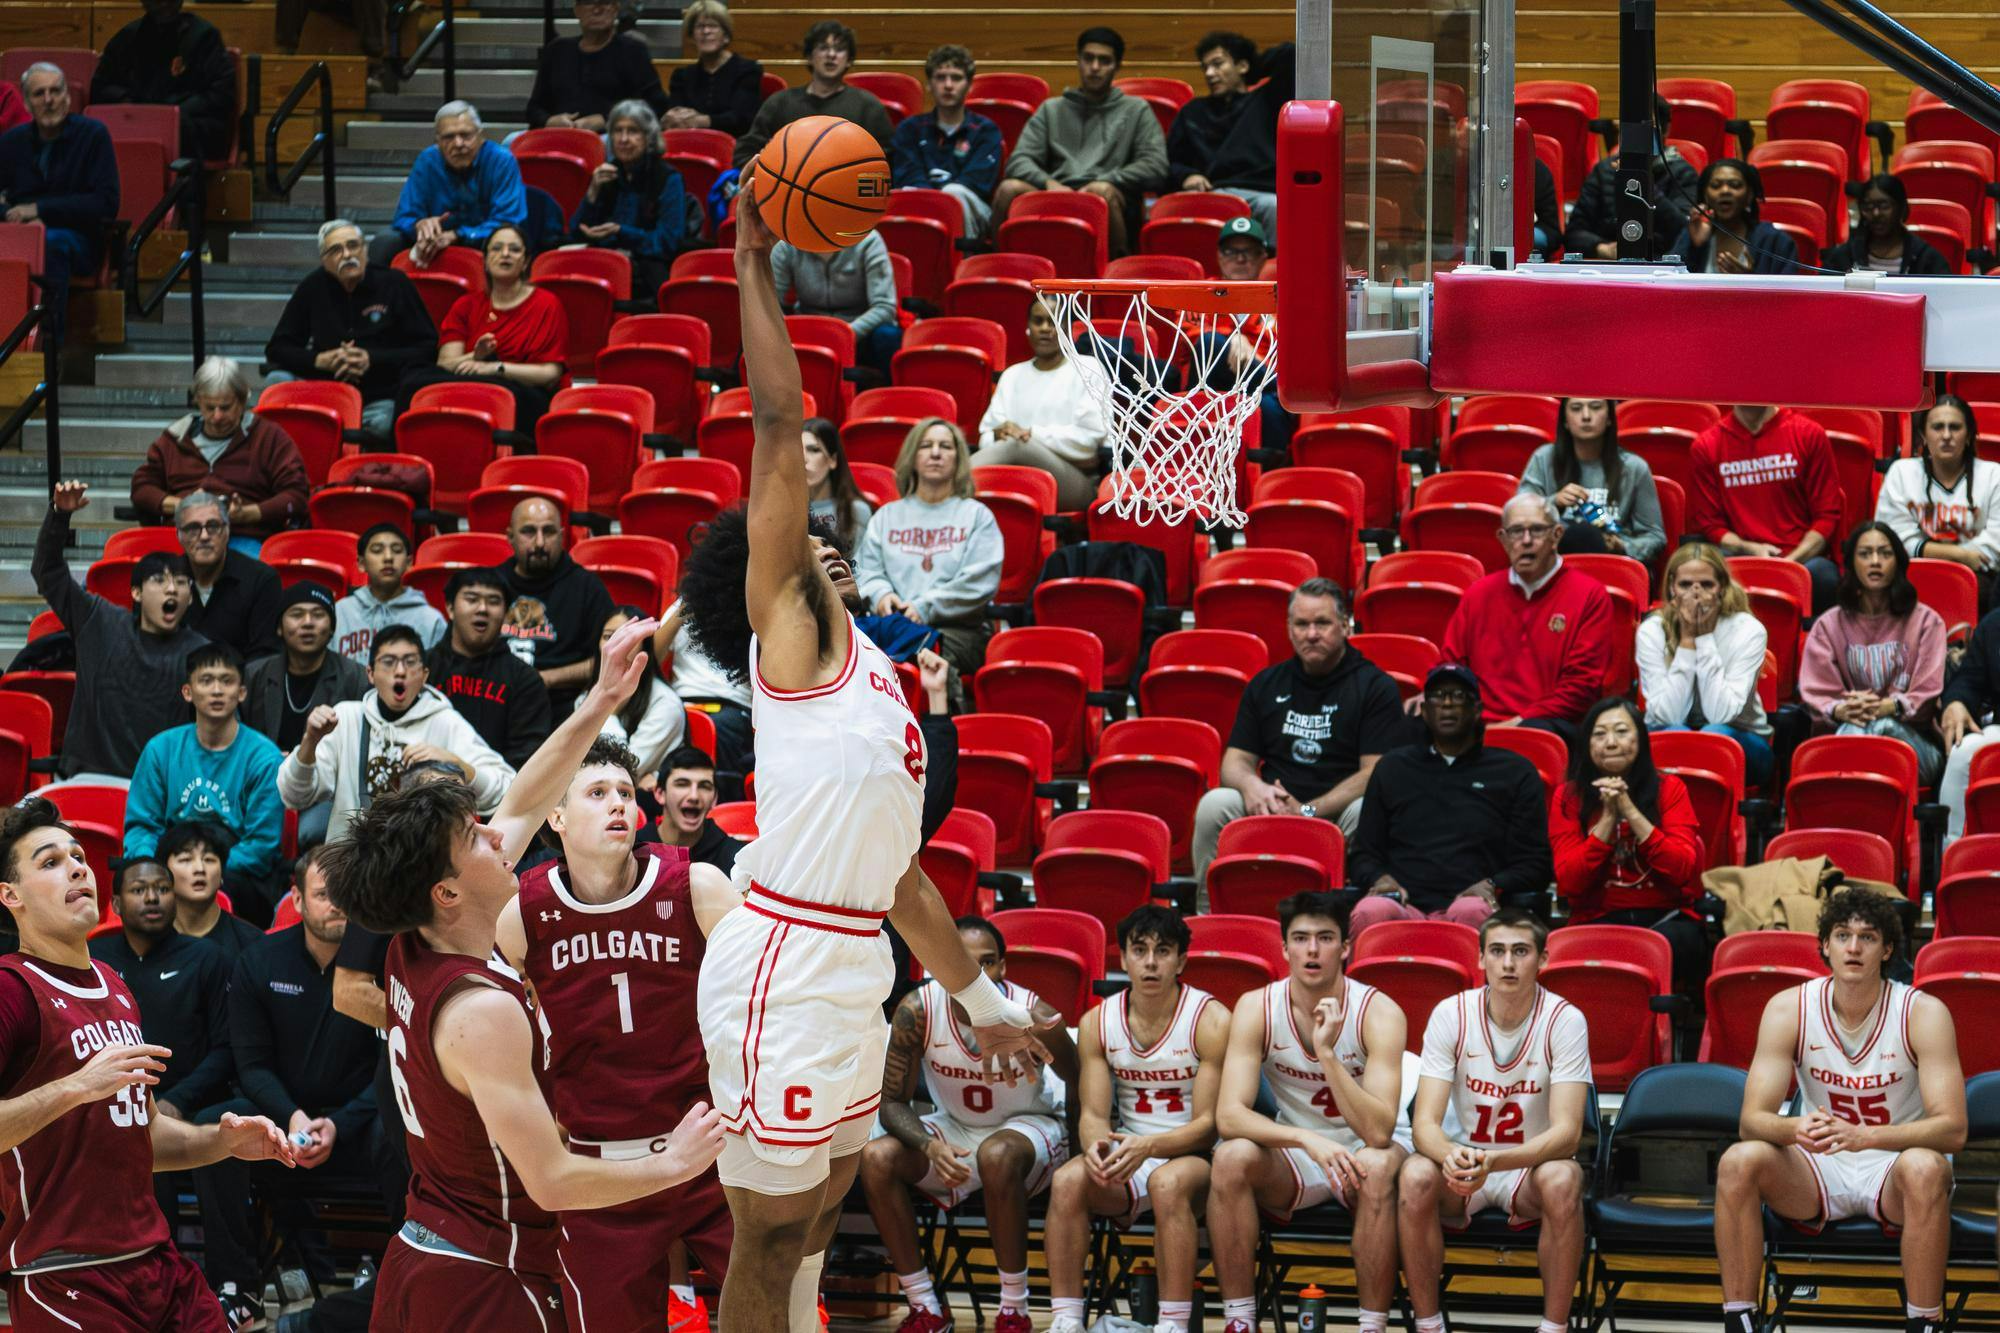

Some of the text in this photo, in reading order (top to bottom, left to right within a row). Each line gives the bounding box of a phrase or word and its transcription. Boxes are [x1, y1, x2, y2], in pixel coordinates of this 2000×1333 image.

[1719, 453, 1798, 476] CORNELL
[1724, 469, 1796, 488] BASKETBALL
[888, 526, 967, 547] CORNELL
[1286, 710, 1332, 729] CORNELL
[551, 930, 680, 971] COLGATE
[611, 972, 634, 1034] 1
[388, 1026, 425, 1139] 6
[1466, 1074, 1542, 1099] CORNELL
[1810, 1067, 1903, 1090] CORNELL
[784, 1085, 812, 1121] C
[962, 1085, 994, 1114] 0
[1311, 1086, 1342, 1118] 4
[1828, 1091, 1890, 1126] 55
[1470, 1102, 1524, 1144] 12
